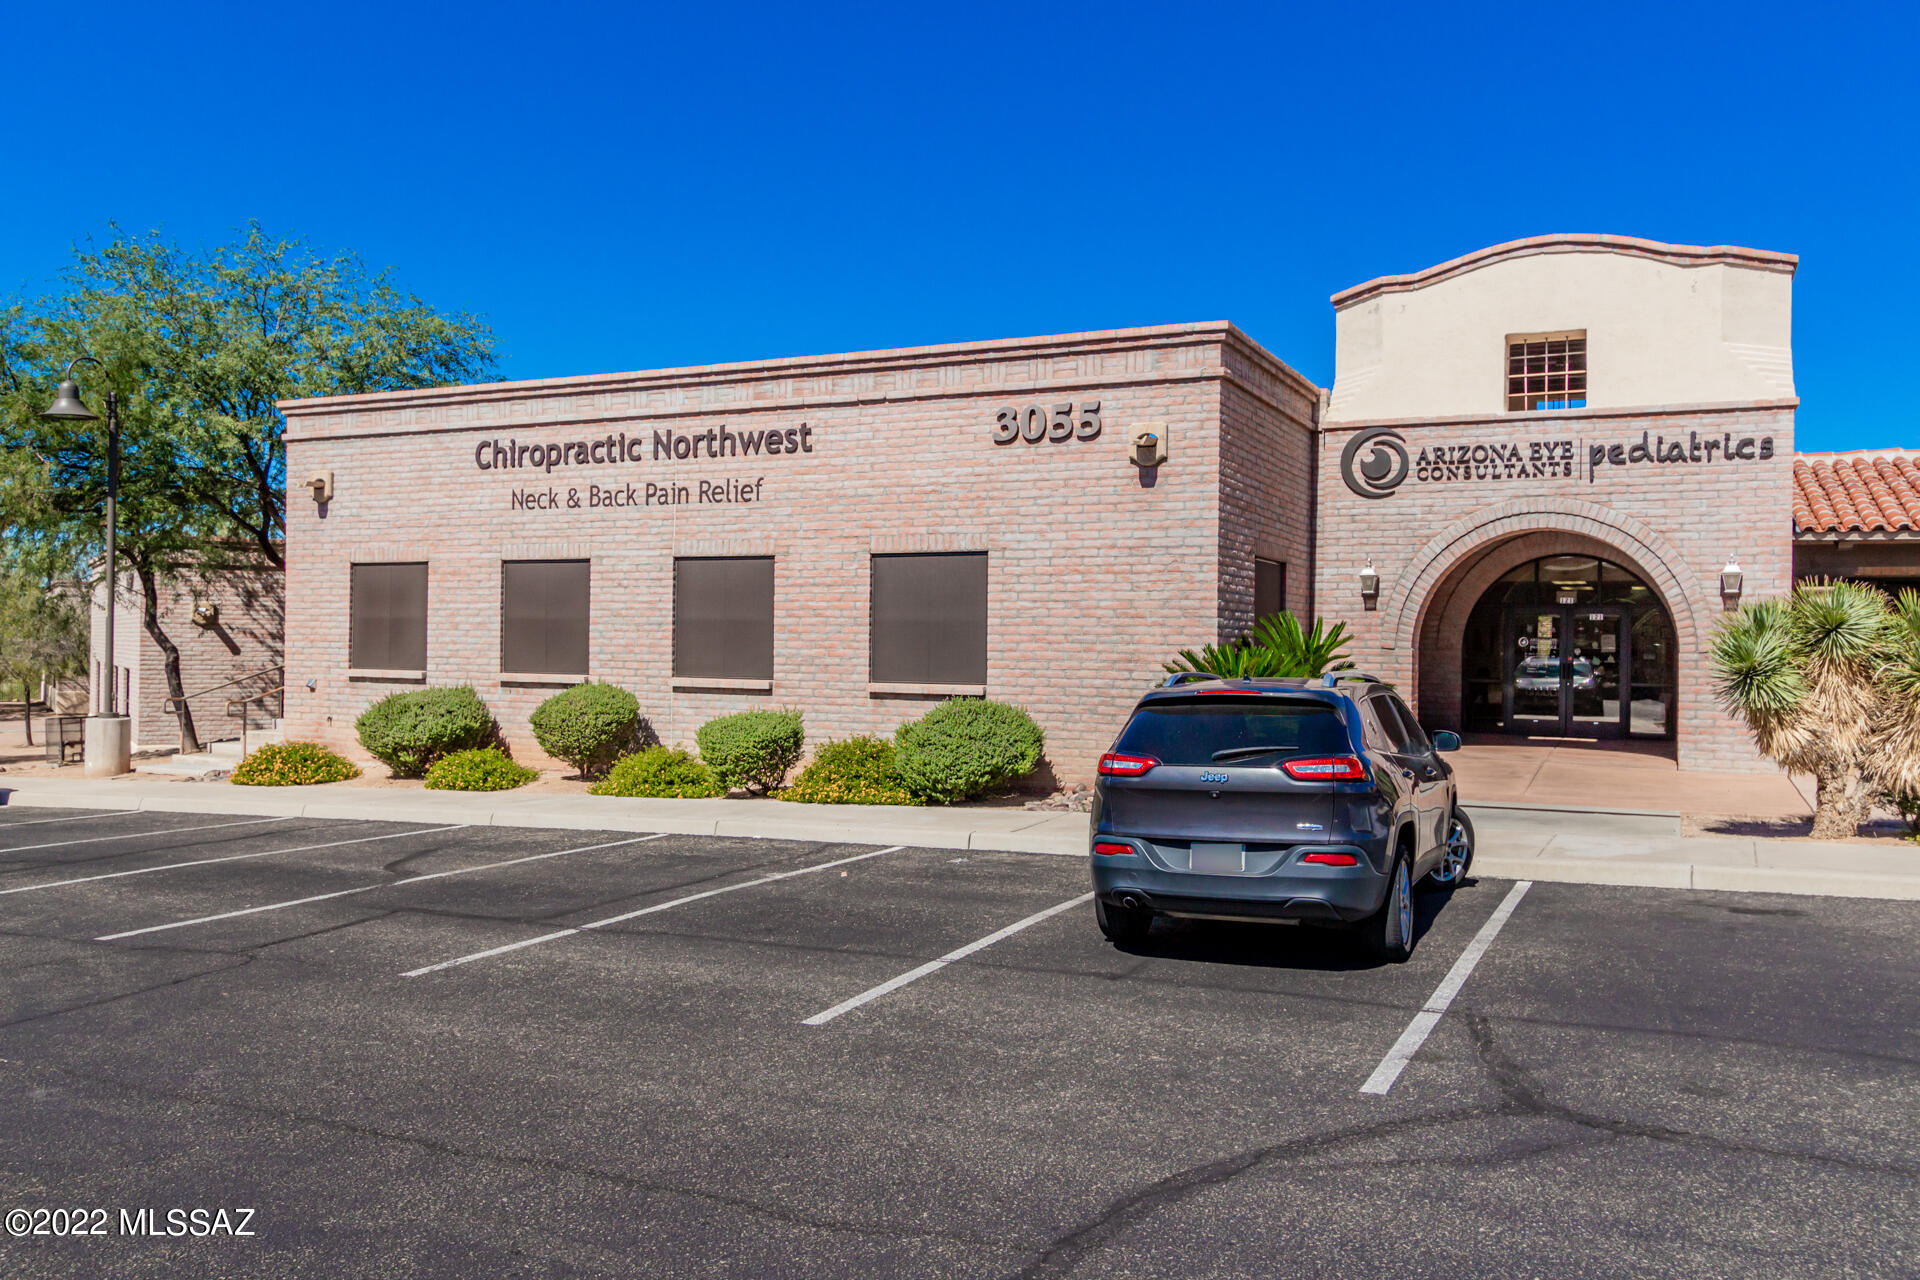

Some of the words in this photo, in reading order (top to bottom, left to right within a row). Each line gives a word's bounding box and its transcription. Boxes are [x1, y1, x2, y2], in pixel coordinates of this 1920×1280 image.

[992, 401, 1102, 446] 3055
[475, 432, 643, 473] Chiropractic
[653, 422, 813, 461] Northwest
[1415, 442, 1523, 466] ARIZONA
[1529, 440, 1574, 462] EYE
[1589, 430, 1774, 484] pediatrics
[1416, 461, 1573, 482] CONSULTANTS
[511, 487, 559, 510] Neck
[566, 487, 582, 509] &
[589, 483, 638, 508] Back
[645, 481, 690, 506] Pain
[699, 477, 764, 504] Relief
[1200, 771, 1229, 784] Jeep
